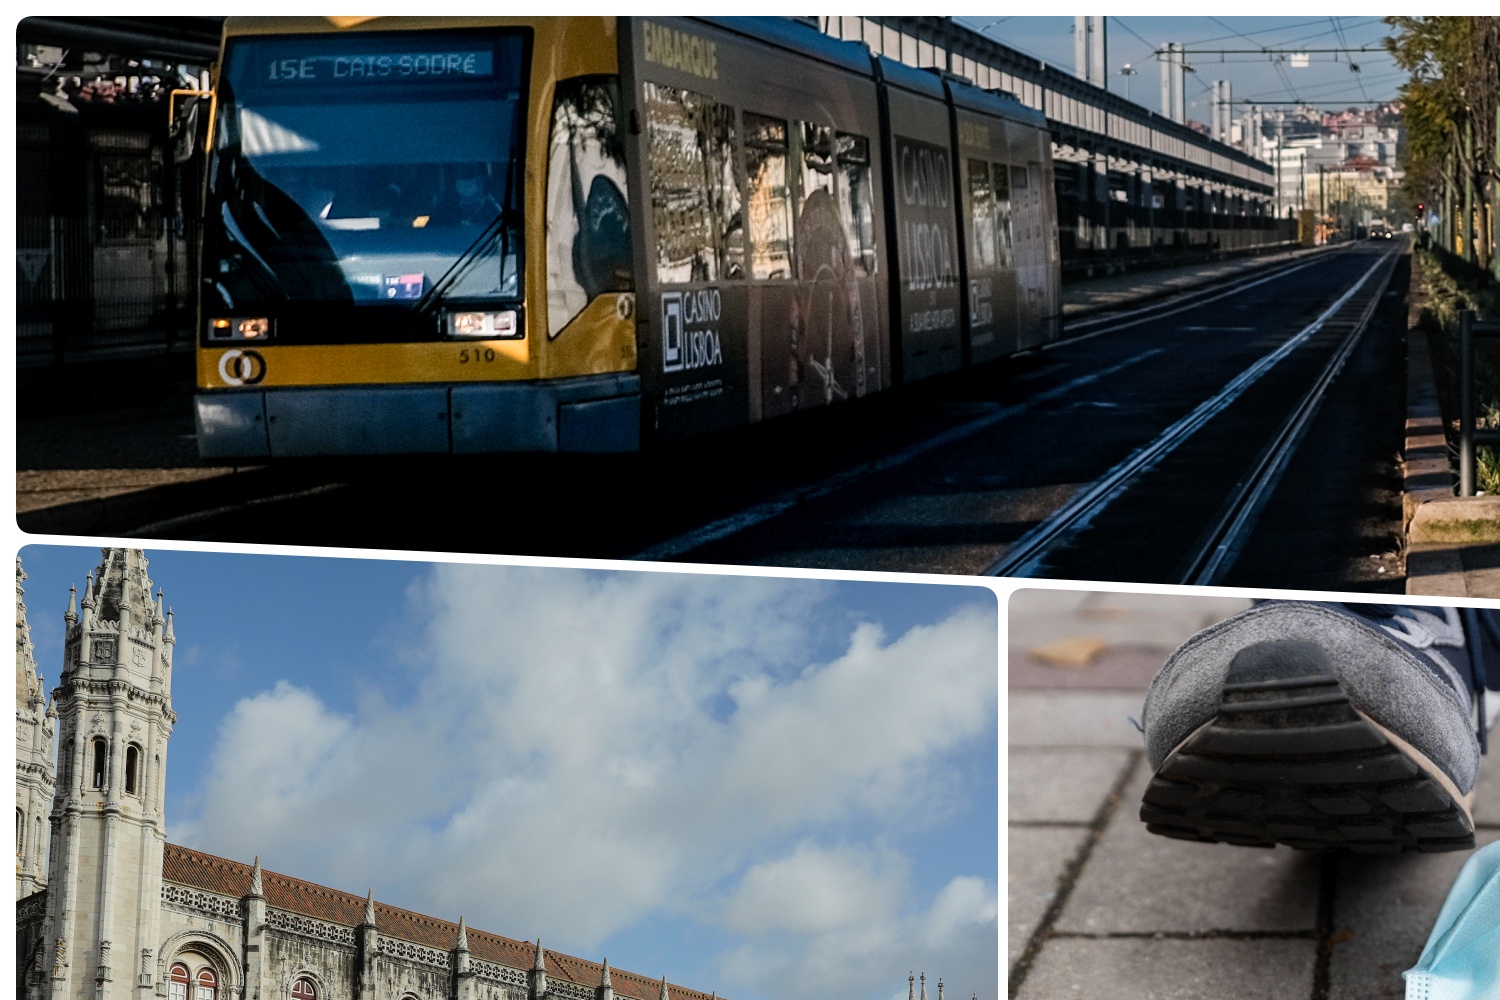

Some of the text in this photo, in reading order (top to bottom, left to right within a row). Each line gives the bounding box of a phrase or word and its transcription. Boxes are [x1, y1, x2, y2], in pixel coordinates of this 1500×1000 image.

[268, 59, 316, 79] 15E
[334, 56, 392, 78] CAIS
[643, 21, 718, 79] EMBARQUE
[903, 146, 949, 208] CASINO
[905, 221, 954, 291] LISBOA
[684, 290, 721, 323] CASINO
[460, 348, 495, 363] 510
[685, 330, 722, 369] LISBOA
